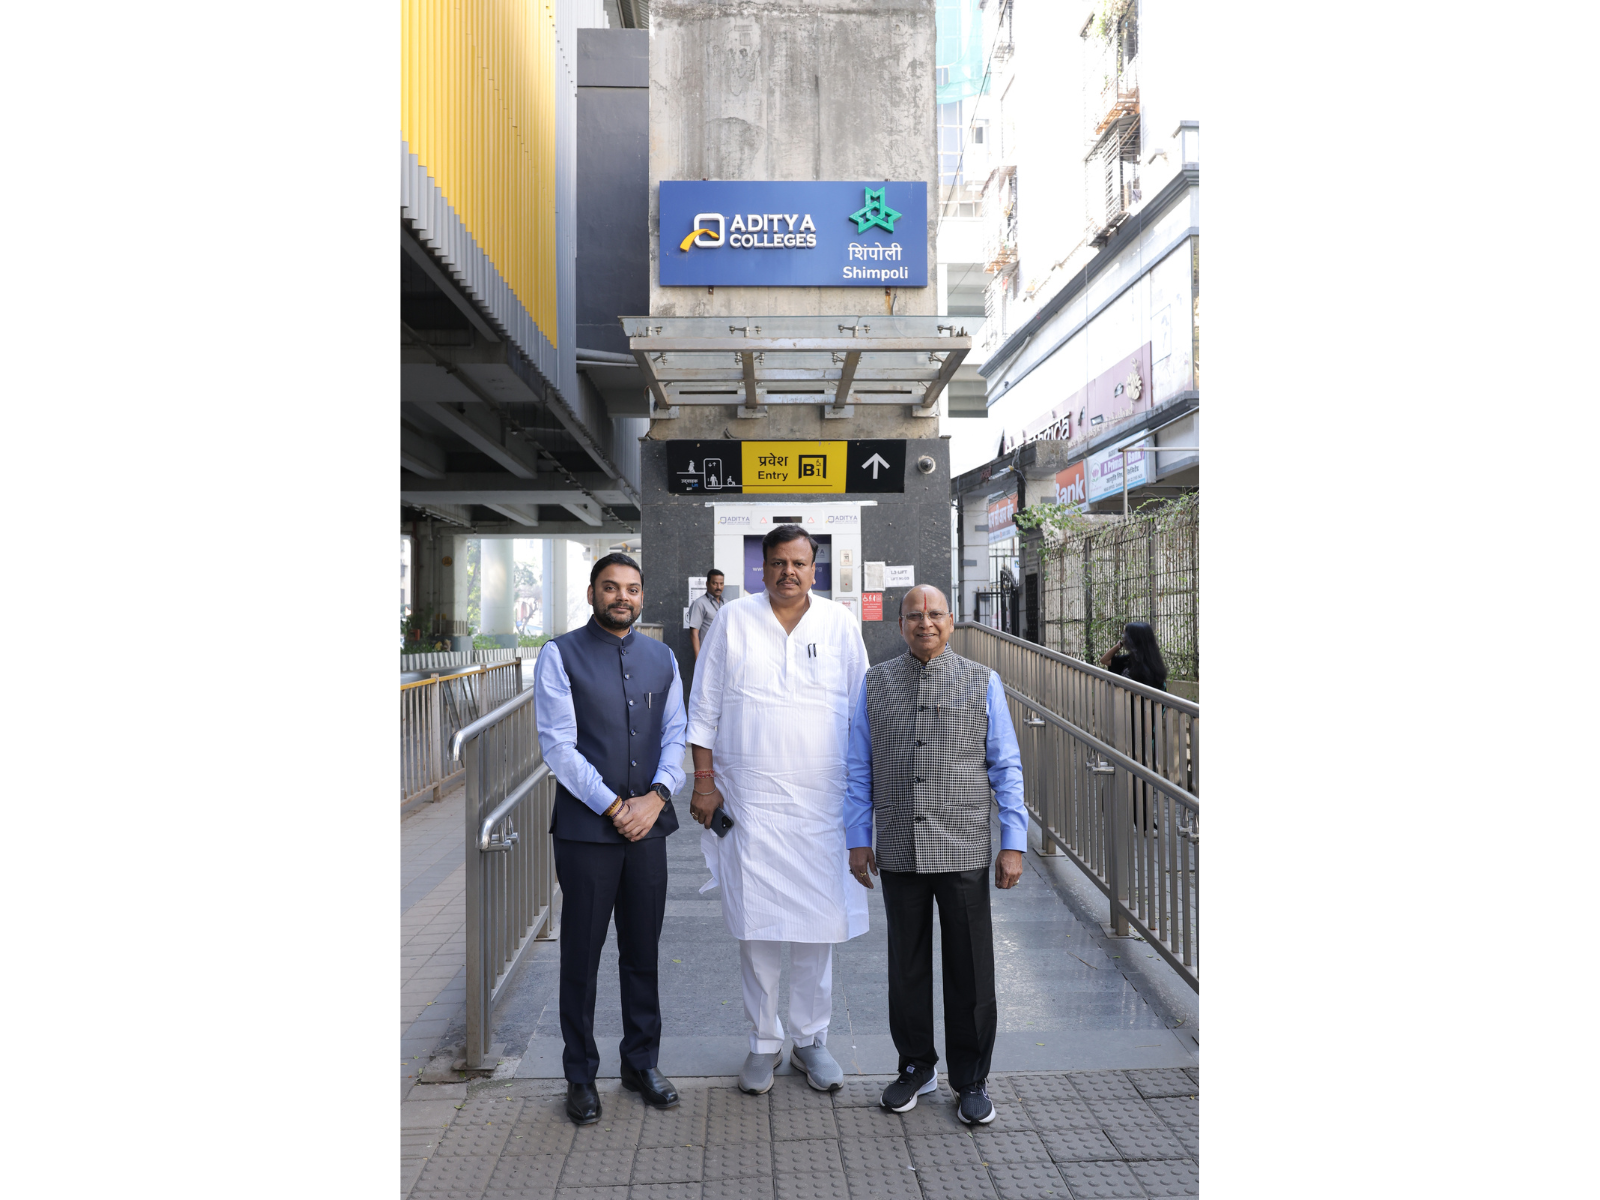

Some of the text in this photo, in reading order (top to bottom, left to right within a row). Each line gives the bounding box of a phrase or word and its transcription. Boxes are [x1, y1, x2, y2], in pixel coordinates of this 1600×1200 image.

[730, 213, 817, 234] ADITYA
[729, 233, 817, 249] COLLEGES
[848, 243, 903, 261] शिंपोली
[842, 266, 909, 282] Shimpoli
[757, 452, 789, 467] प्रवेश
[758, 470, 788, 482] Entry
